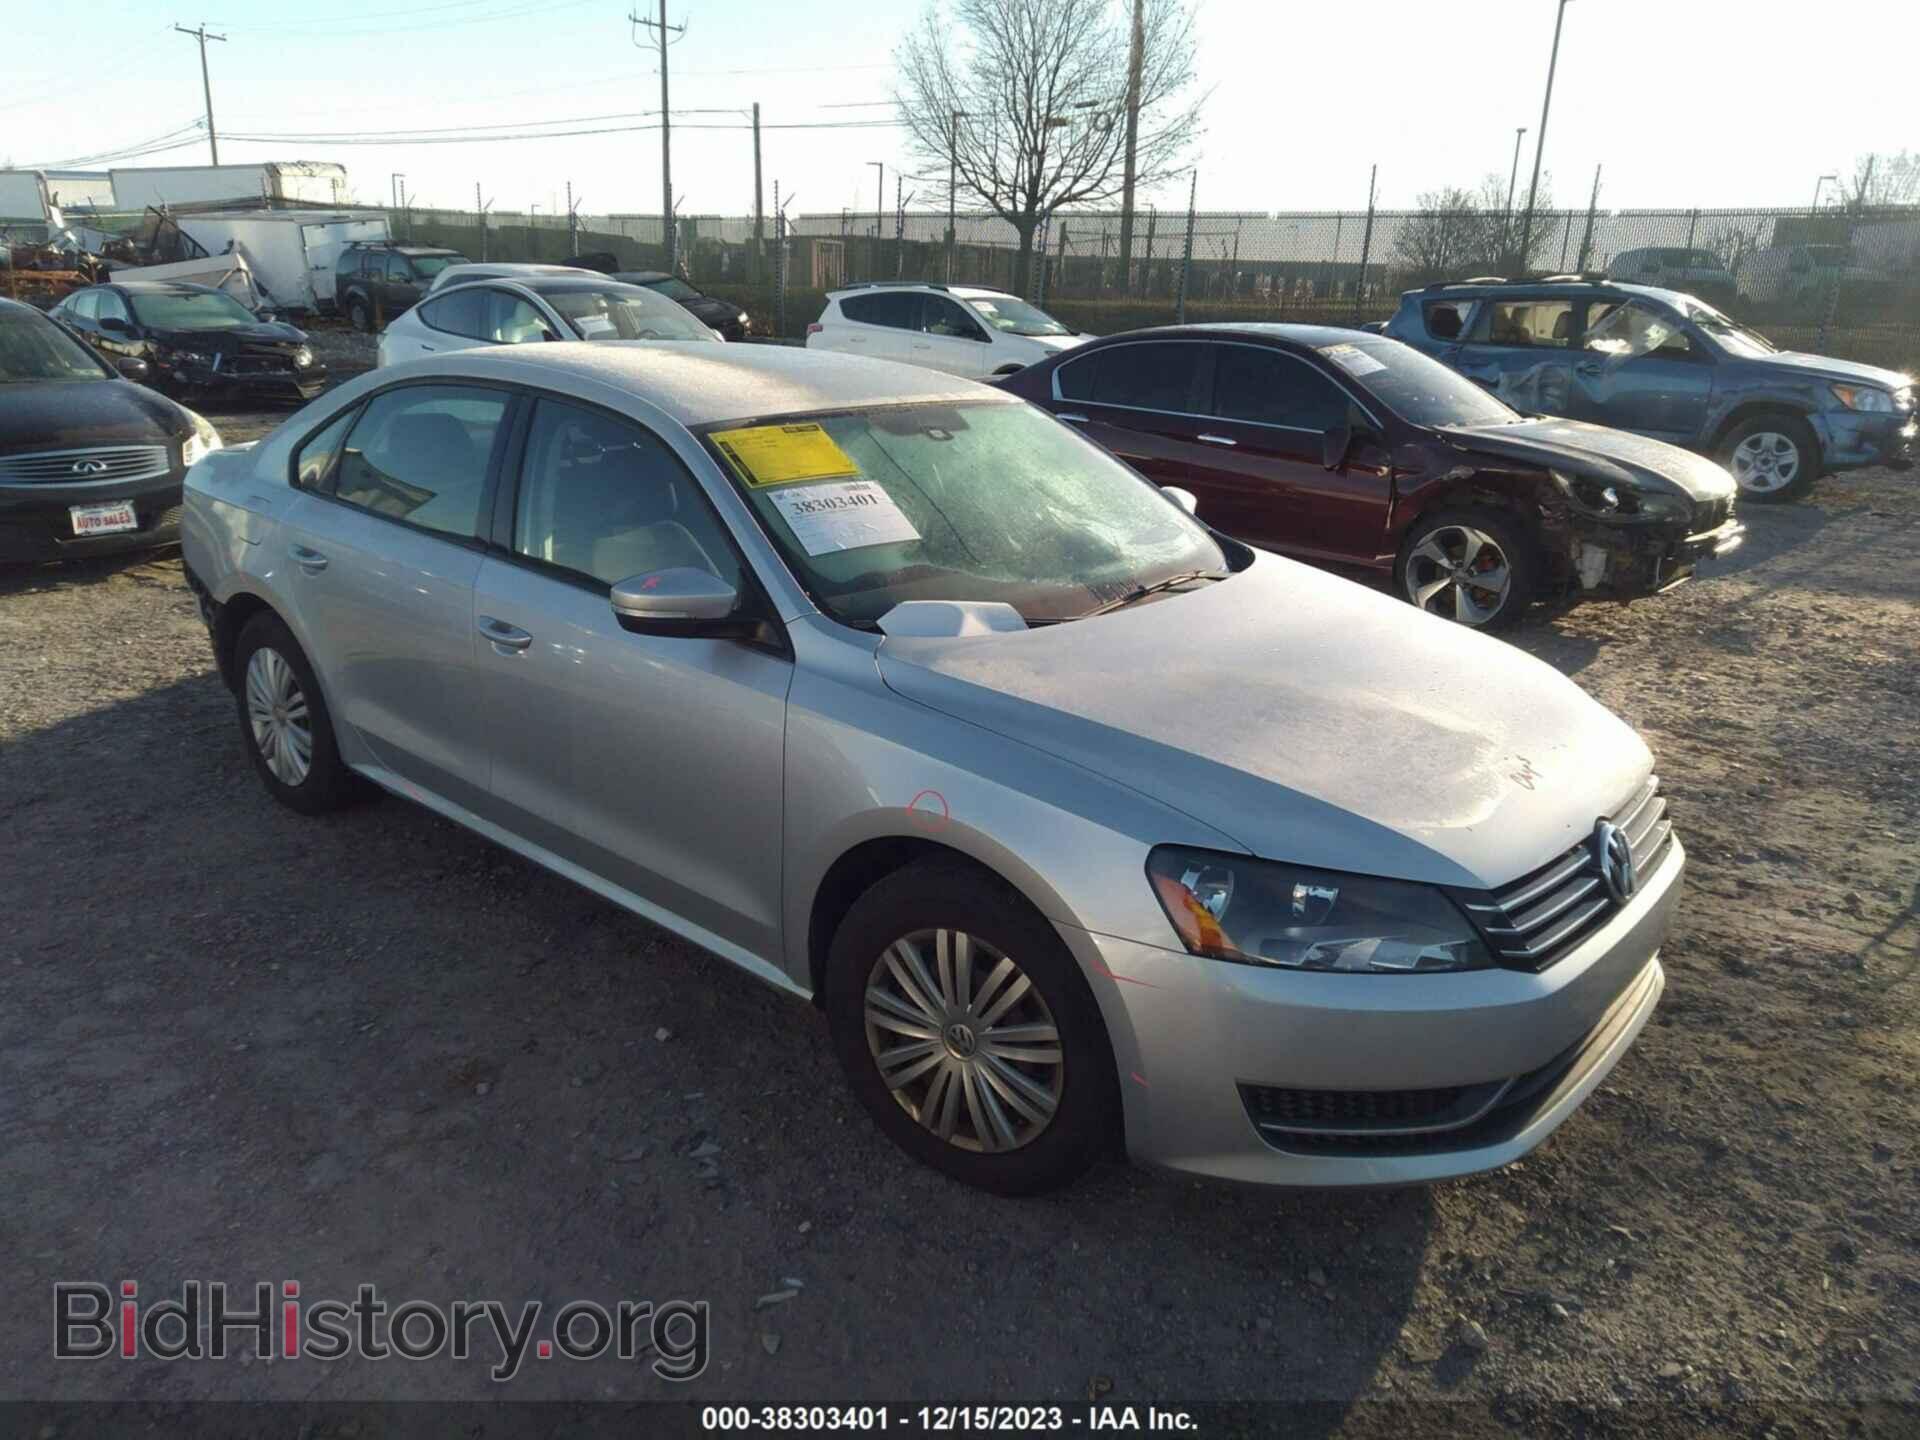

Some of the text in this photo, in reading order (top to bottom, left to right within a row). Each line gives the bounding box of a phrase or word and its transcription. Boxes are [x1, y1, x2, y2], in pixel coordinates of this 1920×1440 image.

[791, 493, 878, 513] 38303401
[76, 511, 130, 529] AUTO SALES
